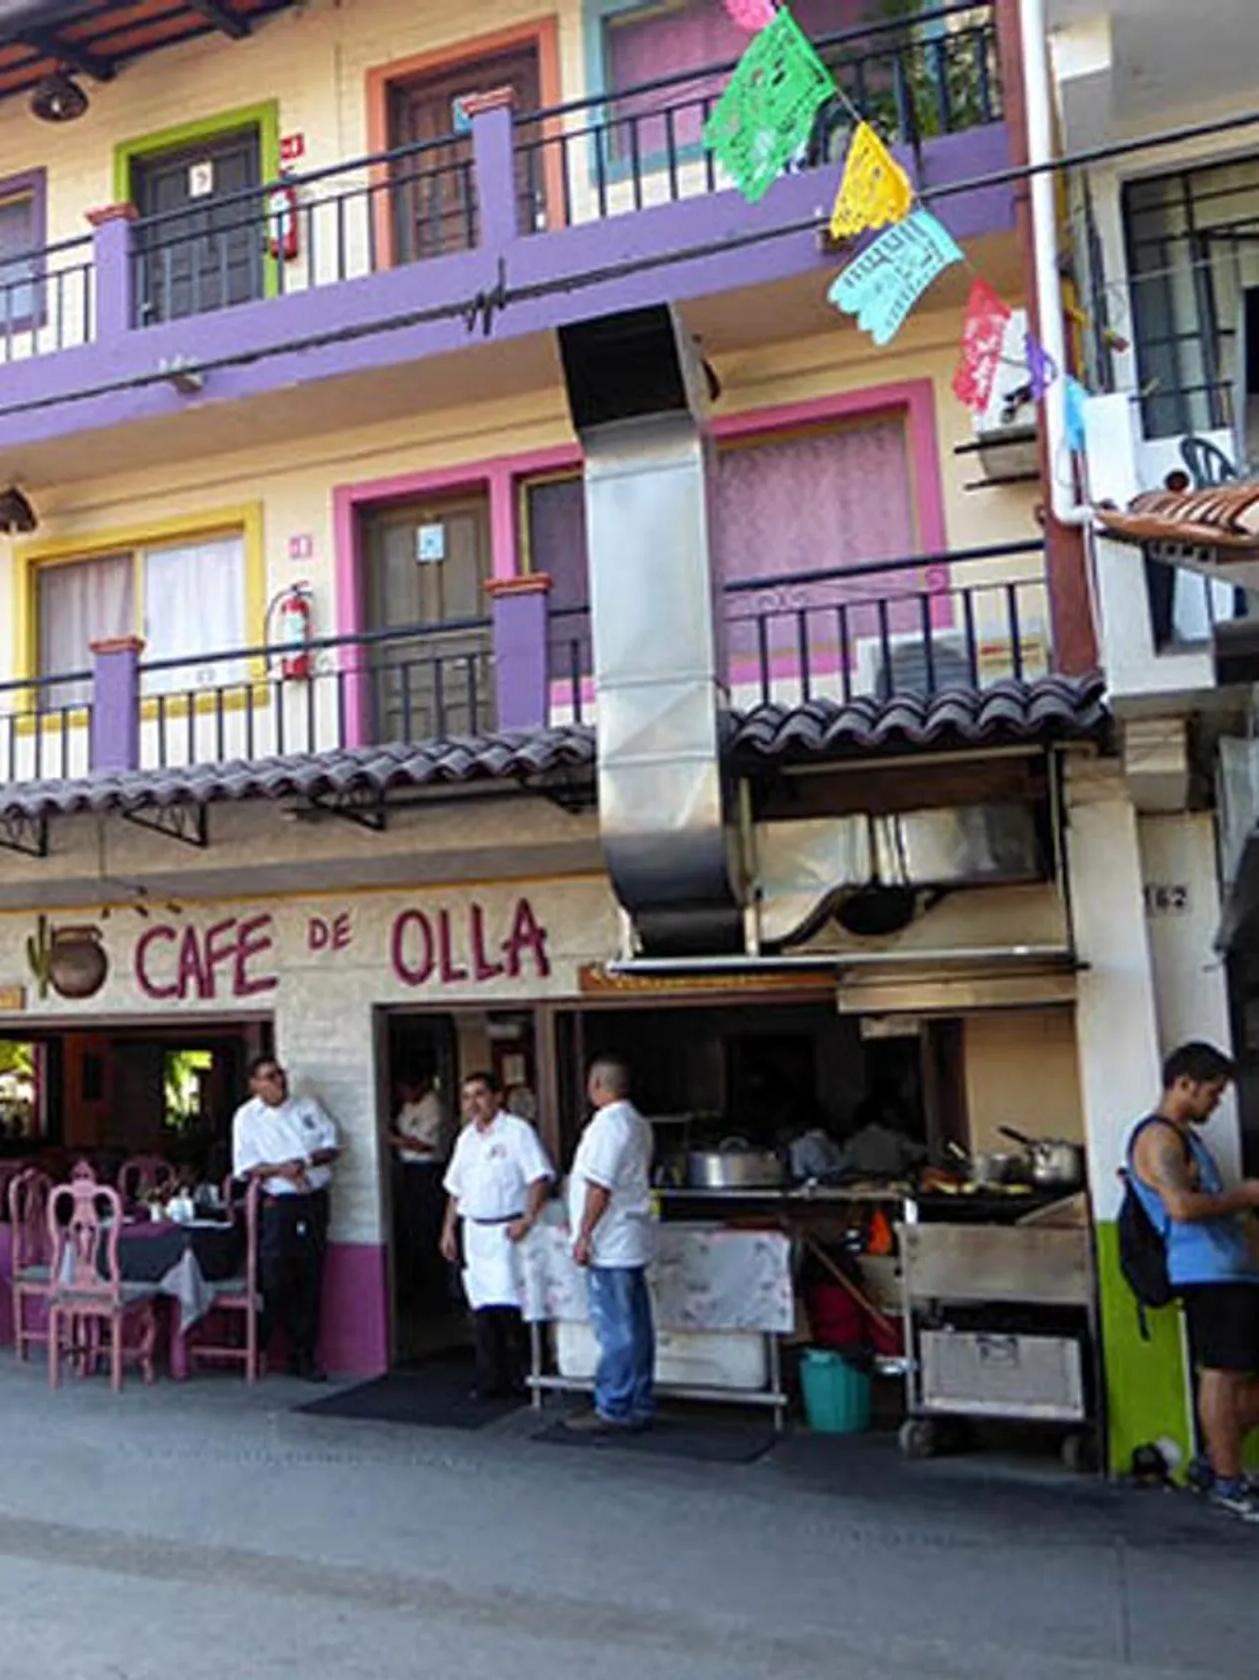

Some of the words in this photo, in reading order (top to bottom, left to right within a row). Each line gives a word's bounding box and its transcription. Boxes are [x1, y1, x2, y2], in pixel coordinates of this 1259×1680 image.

[135, 912, 279, 999] CAFE
[308, 911, 352, 950] DE
[392, 898, 551, 986] OLLA
